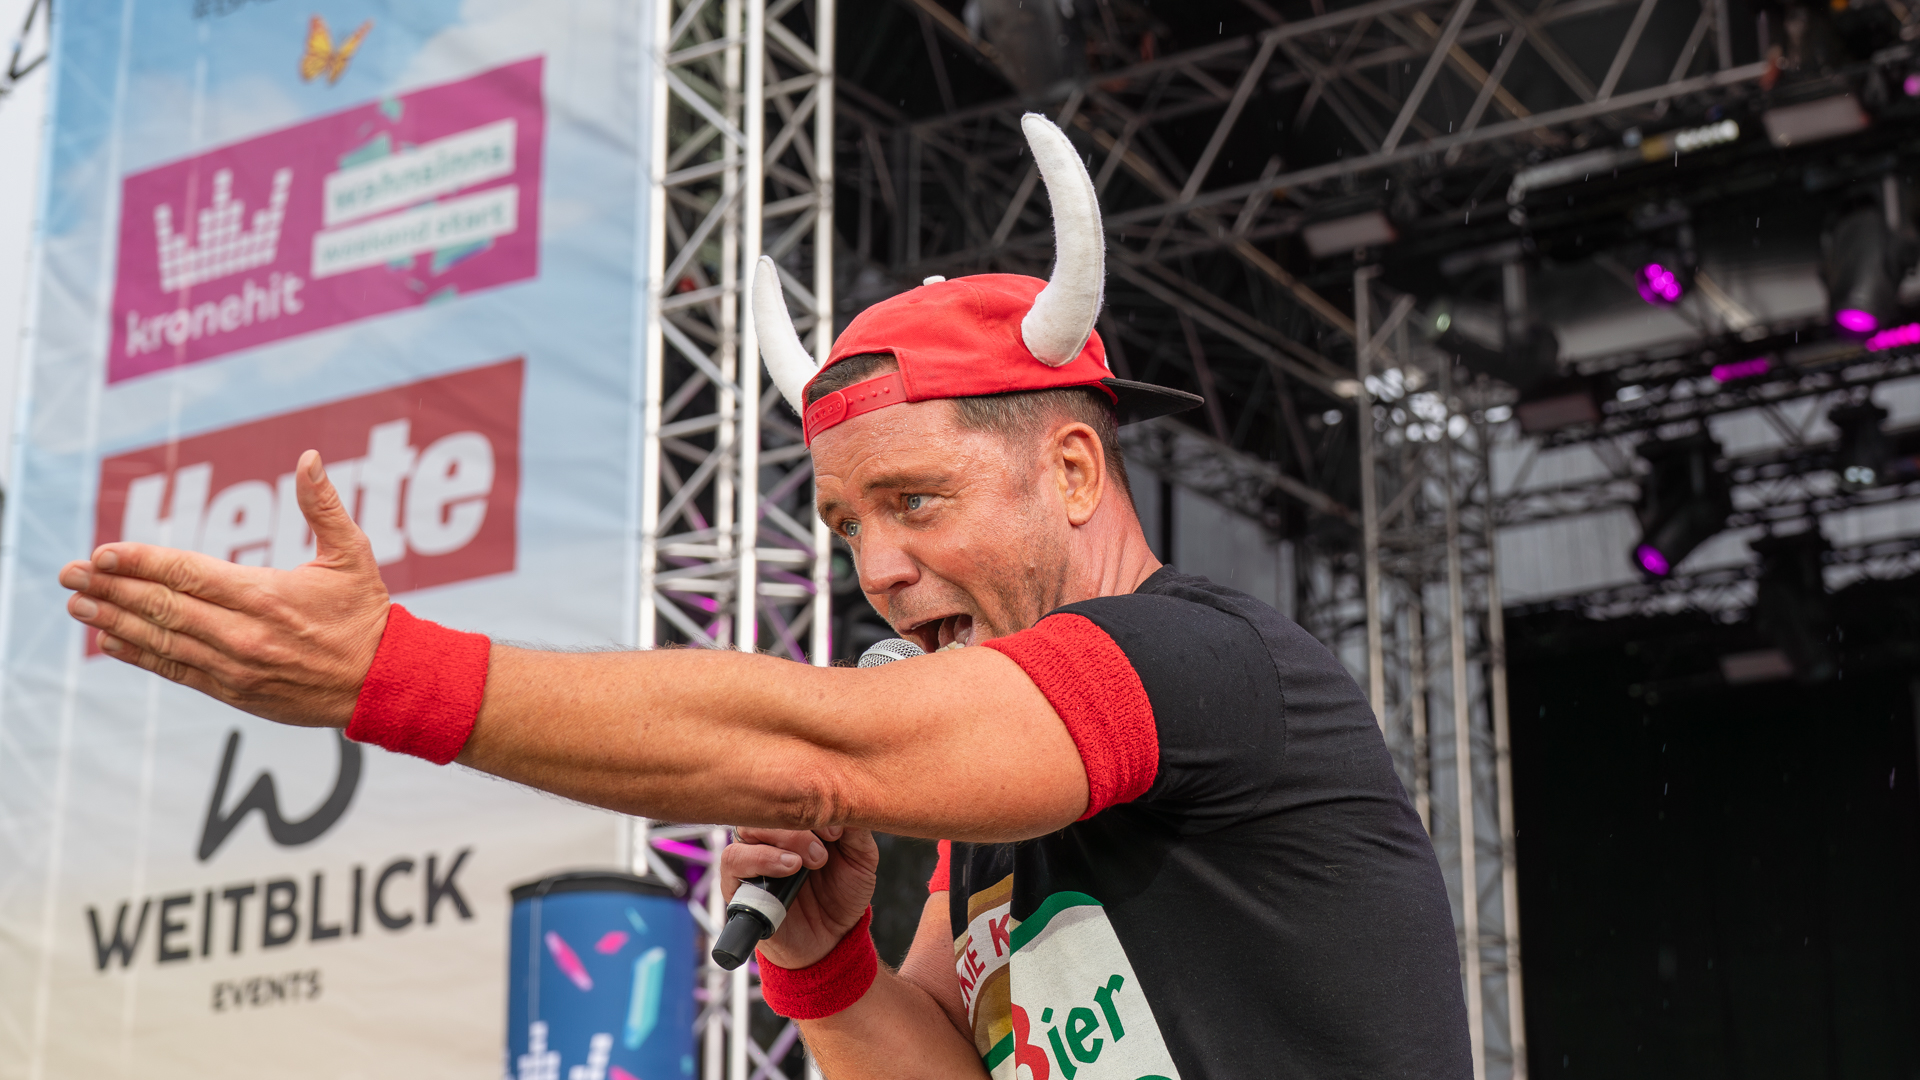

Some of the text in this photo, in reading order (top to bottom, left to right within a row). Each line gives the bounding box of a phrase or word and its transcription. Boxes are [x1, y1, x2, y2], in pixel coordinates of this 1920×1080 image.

[126, 270, 305, 359] kronehit
[86, 845, 476, 972] WEITBLICK
[210, 967, 322, 1014] EVENTS
